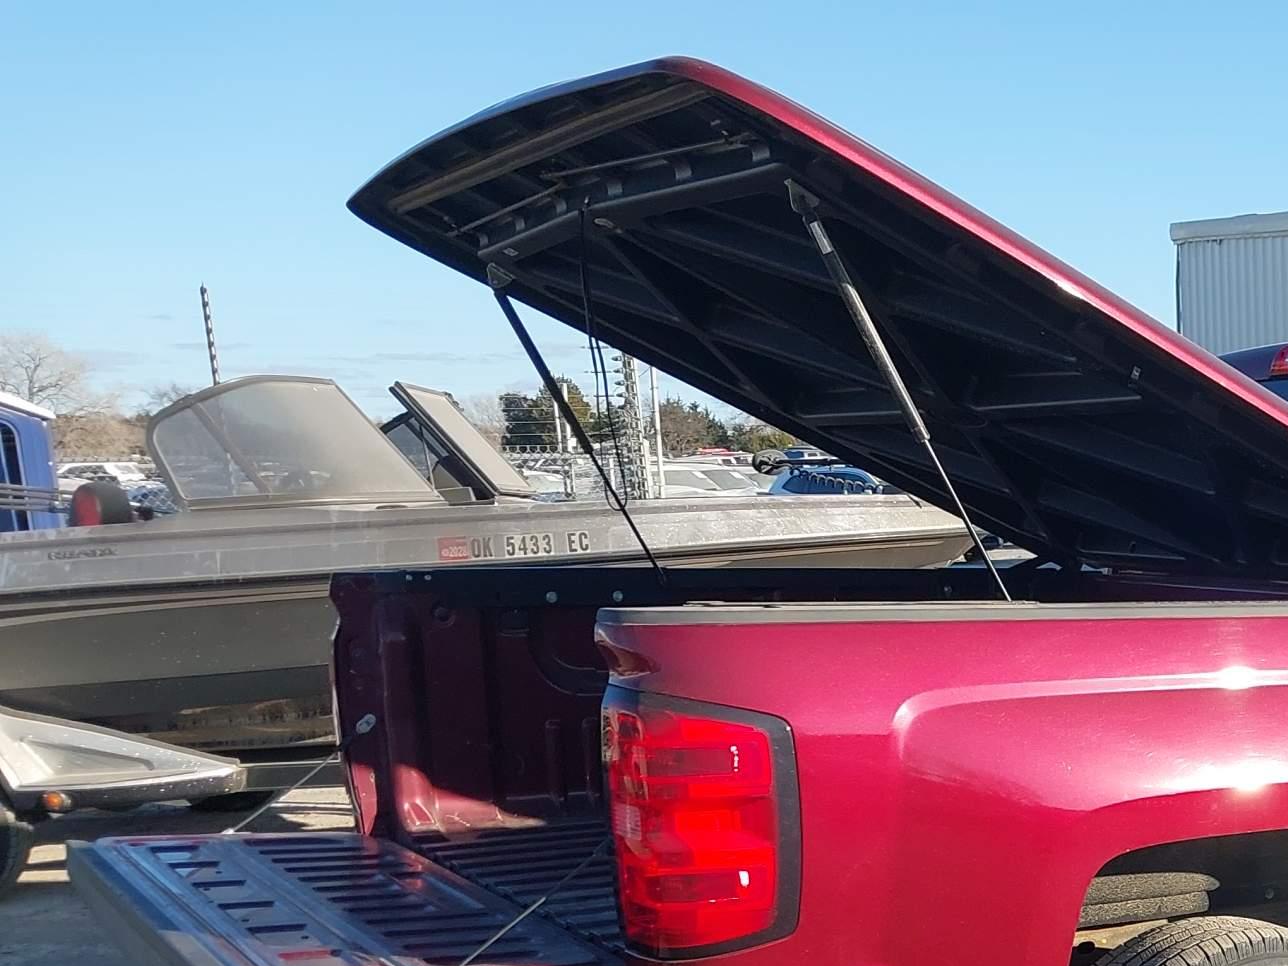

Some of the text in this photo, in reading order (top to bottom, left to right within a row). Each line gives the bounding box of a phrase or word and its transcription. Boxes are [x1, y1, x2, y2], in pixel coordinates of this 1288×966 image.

[471, 532, 590, 558] OK 5433 EC
